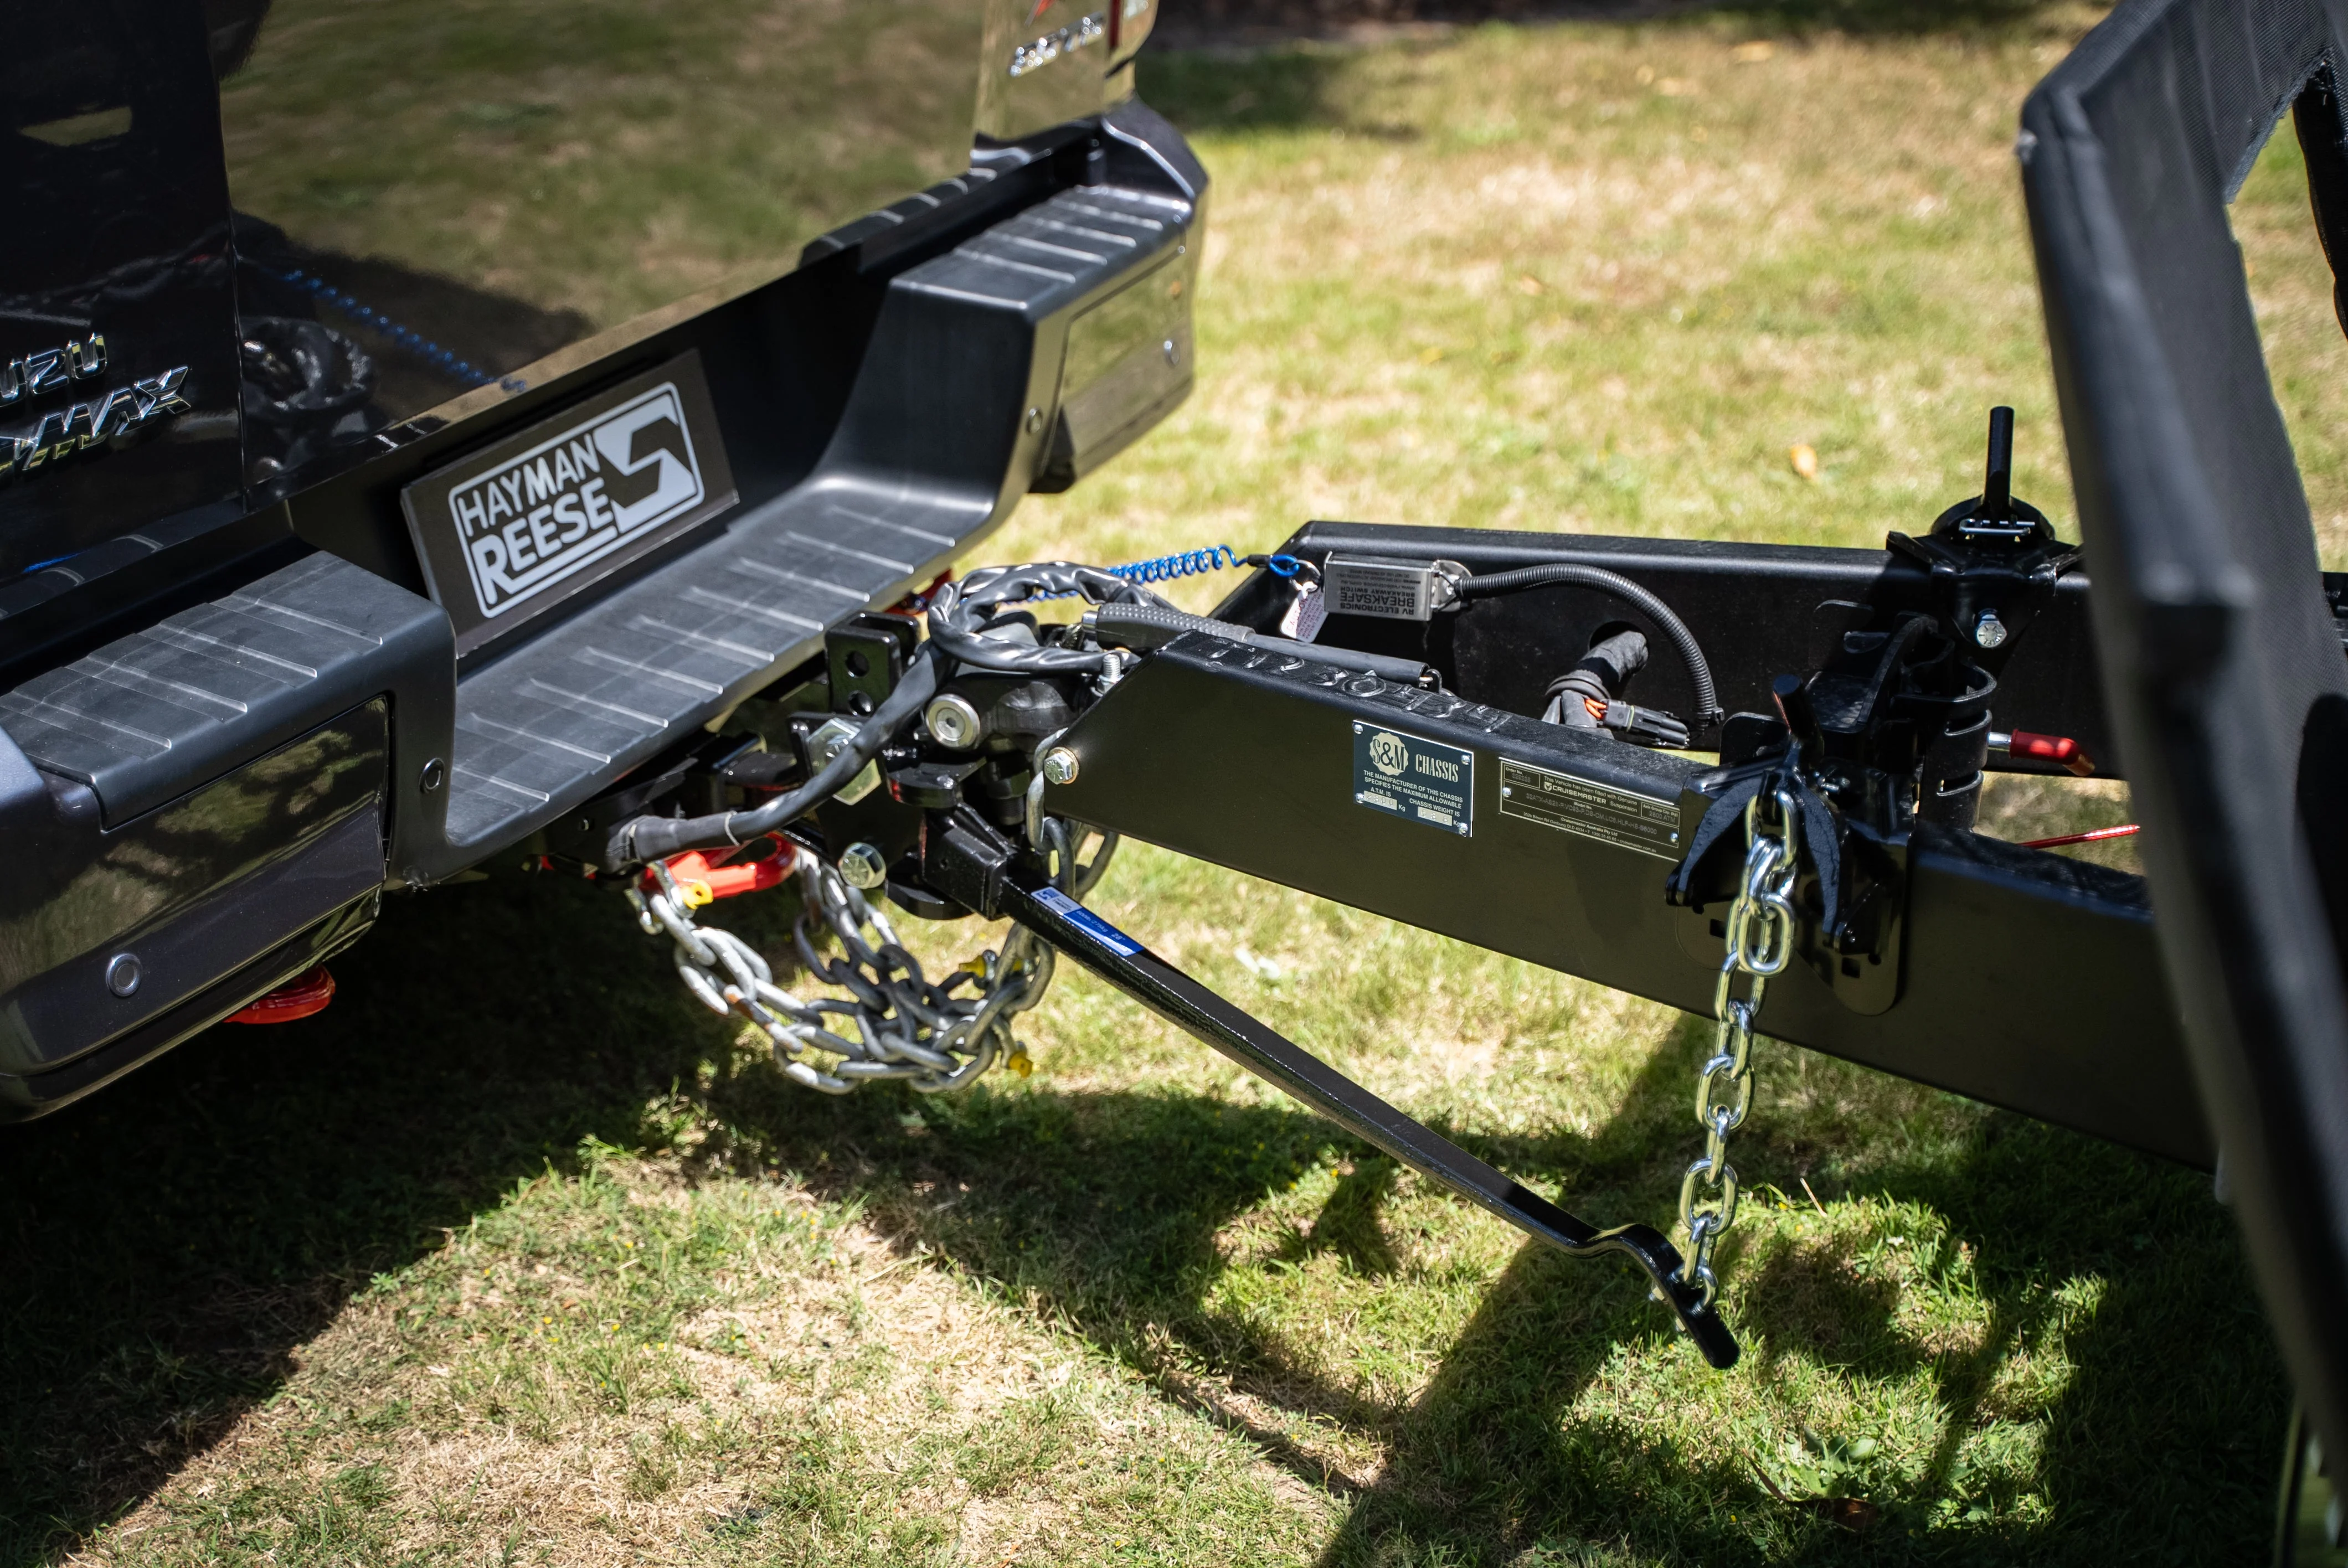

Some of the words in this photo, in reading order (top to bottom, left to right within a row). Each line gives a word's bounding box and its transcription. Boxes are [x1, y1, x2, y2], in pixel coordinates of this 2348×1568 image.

[457, 434, 600, 535] HAYMAN
[471, 477, 615, 604] REESE
[1340, 591, 1414, 607] BREAKSAFE
[1340, 602, 1399, 613] ELECTRONICS
[1373, 738, 1404, 771] S&M
[1416, 754, 1458, 783] CHASSIS
[1364, 777, 1391, 789] SPECIFIES
[1403, 788, 1428, 800] MAXIMUM
[1429, 795, 1461, 809] ALLOWABLE
[1375, 773, 1416, 789] MANUFACTURER
[1440, 792, 1463, 802] CHASSIS
[1553, 785, 1606, 804] CRUISEMASTER
[1610, 801, 1637, 813] Suspension
[1555, 779, 1571, 787] Vehicle
[1618, 796, 1637, 806] Genuine
[1409, 798, 1432, 808] CHASSIS
[1433, 804, 1453, 815] WEIGHT
[1561, 817, 1585, 828] Cruisemaster
